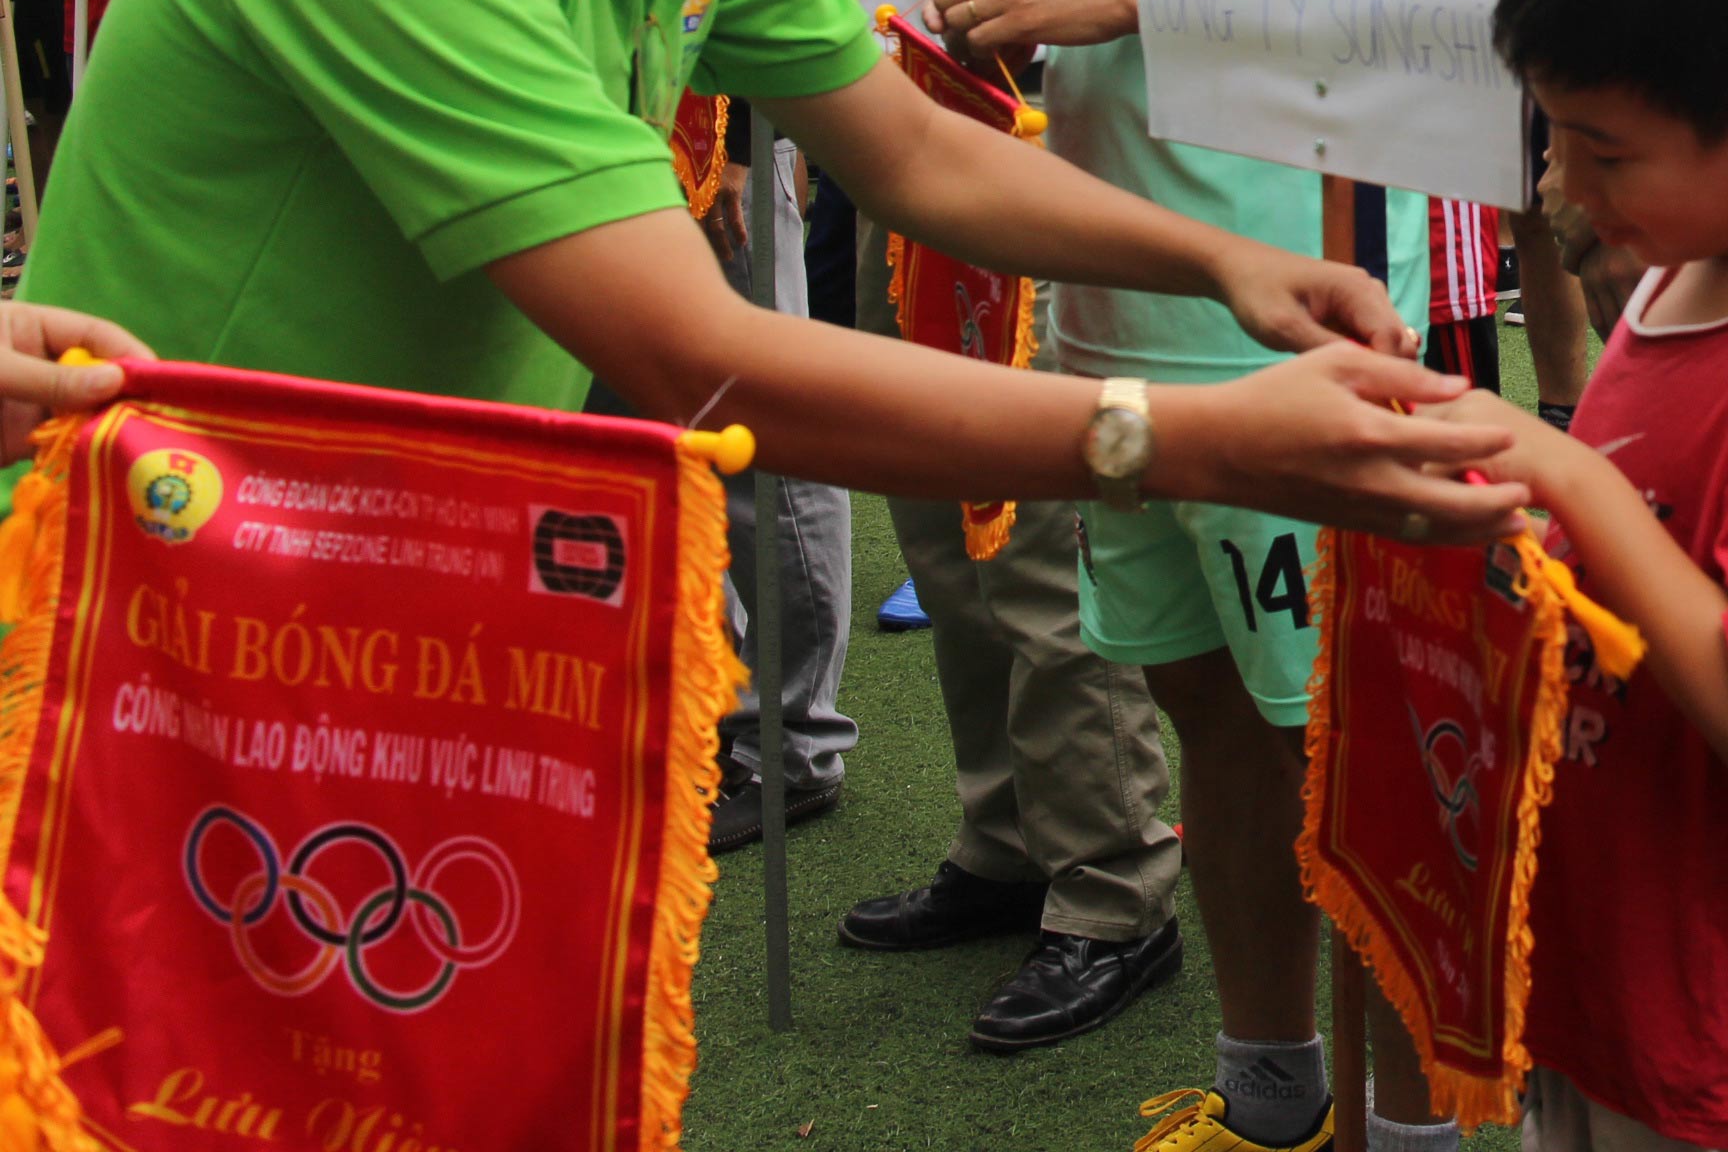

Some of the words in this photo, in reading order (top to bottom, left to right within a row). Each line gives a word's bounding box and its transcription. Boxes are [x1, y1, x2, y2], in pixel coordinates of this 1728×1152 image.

[237, 470, 285, 507] CÔNG
[233, 519, 272, 552] CTY
[1220, 532, 1311, 633] 14
[126, 576, 217, 675] GIẢI
[230, 602, 398, 695] BÓNG
[413, 622, 487, 705] ĐÁ
[504, 646, 605, 730] MINI
[113, 672, 181, 739] CÔNG
[233, 718, 286, 769] LAO
[292, 712, 367, 782] ĐỘNG
[370, 730, 425, 784] KHU
[480, 744, 536, 801] LINH
[538, 754, 597, 819] TRUNG
[1225, 1079, 1306, 1100] adidas
